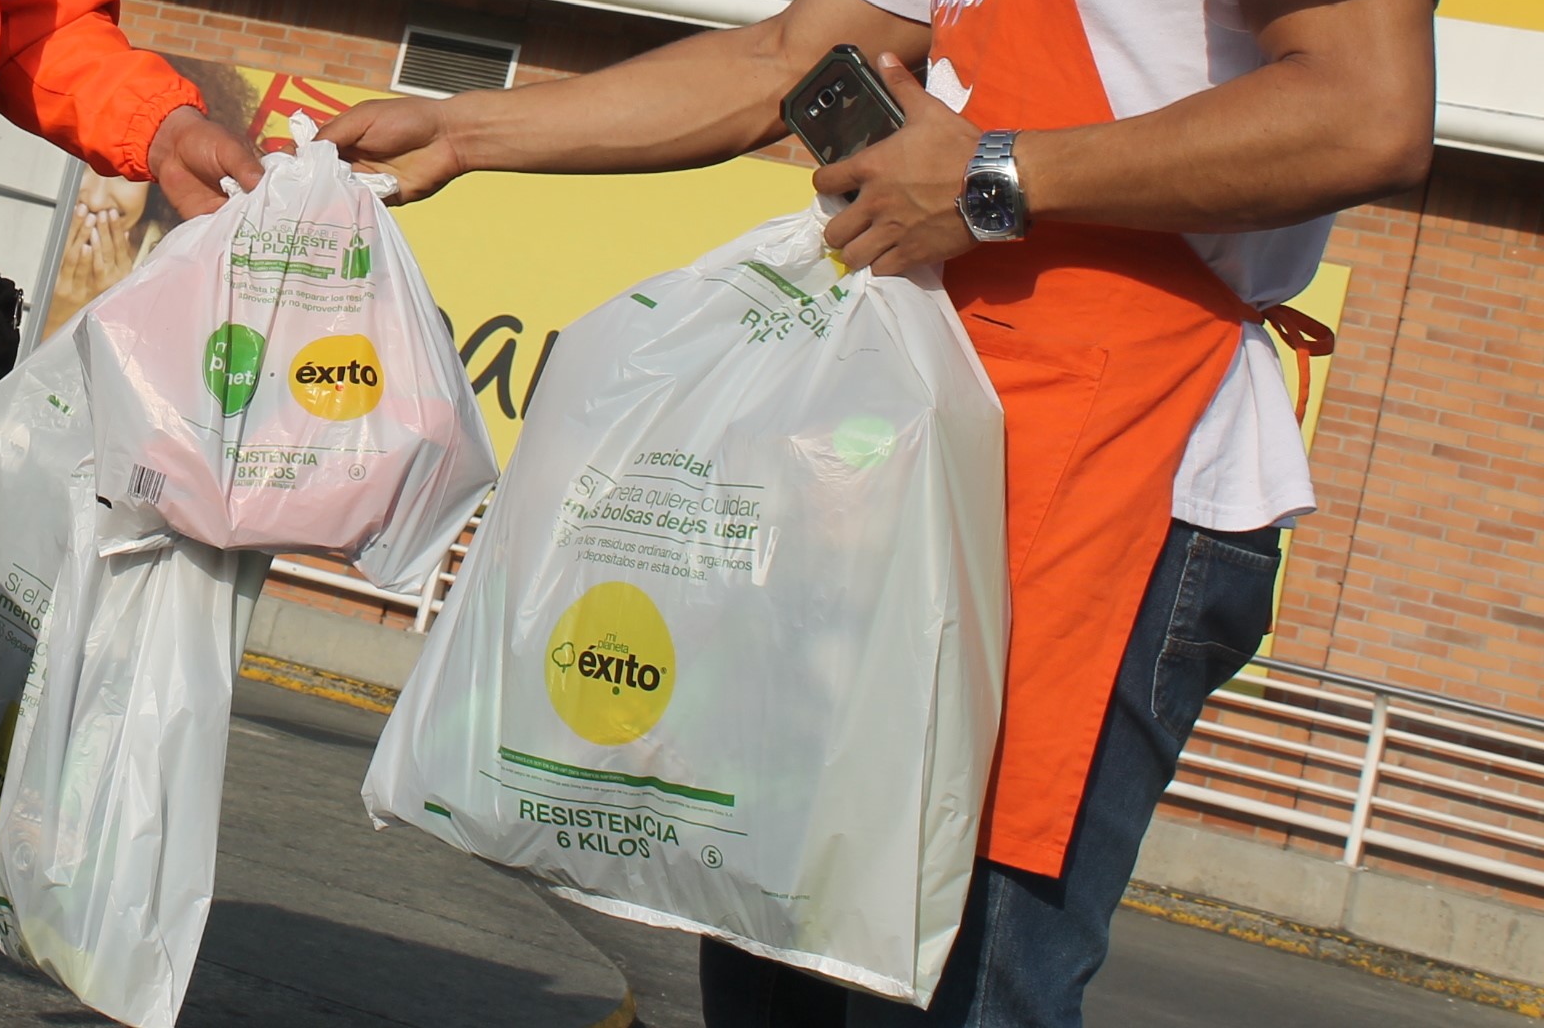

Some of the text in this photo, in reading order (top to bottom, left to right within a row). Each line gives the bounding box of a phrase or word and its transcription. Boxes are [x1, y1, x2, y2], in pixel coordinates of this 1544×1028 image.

[288, 299, 301, 308] no
[296, 289, 330, 301] separar
[295, 359, 378, 391] éxito
[238, 466, 246, 478] 8
[575, 474, 599, 500] Si
[645, 487, 698, 516] quiere
[700, 494, 761, 520] cuidar,
[601, 504, 653, 526] bolsas
[713, 521, 758, 540] usar
[597, 536, 636, 553] residuos
[638, 544, 682, 562] ordinarios
[575, 550, 582, 561] y
[637, 559, 649, 571] en
[650, 561, 670, 575] esta
[671, 563, 708, 581] bolsa.
[4, 572, 23, 595] Si
[22, 589, 39, 606] el
[597, 640, 630, 654] planeta
[605, 632, 617, 642] mi
[519, 798, 679, 846] RESISTENCIA
[557, 830, 570, 848] 6
[578, 832, 650, 859] KILOS
